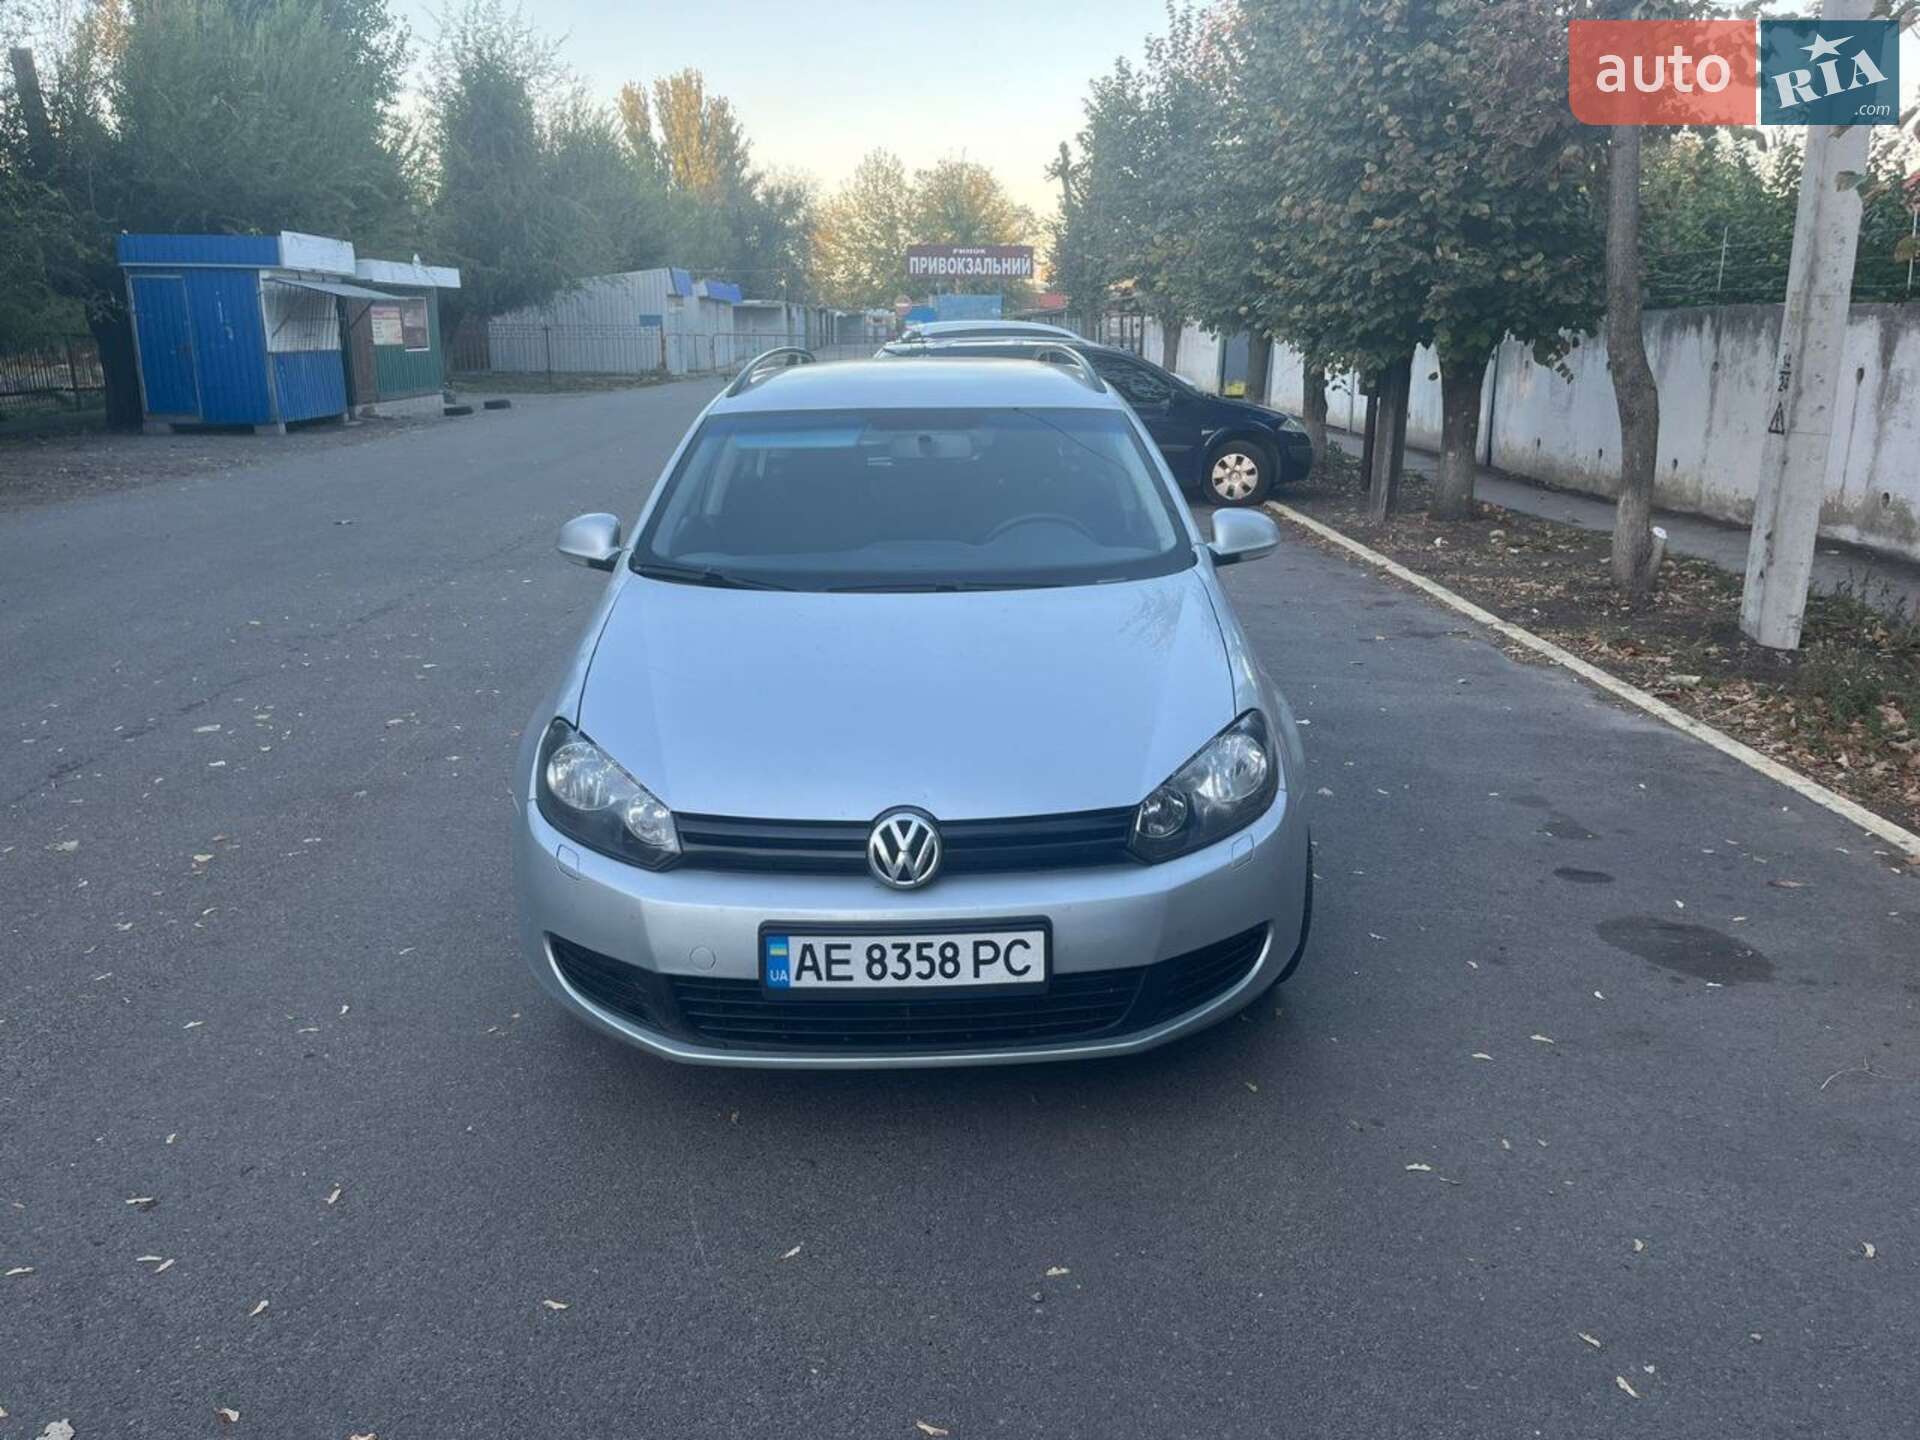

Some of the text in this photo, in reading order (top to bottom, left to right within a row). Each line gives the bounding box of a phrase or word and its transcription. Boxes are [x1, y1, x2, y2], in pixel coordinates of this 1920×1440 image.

[909, 255, 1031, 274] ПРИВОКЗАЛЬНИЙ
[869, 812, 938, 885] VW
[769, 970, 788, 981] UA
[795, 938, 1032, 982] AE 8358 PC
